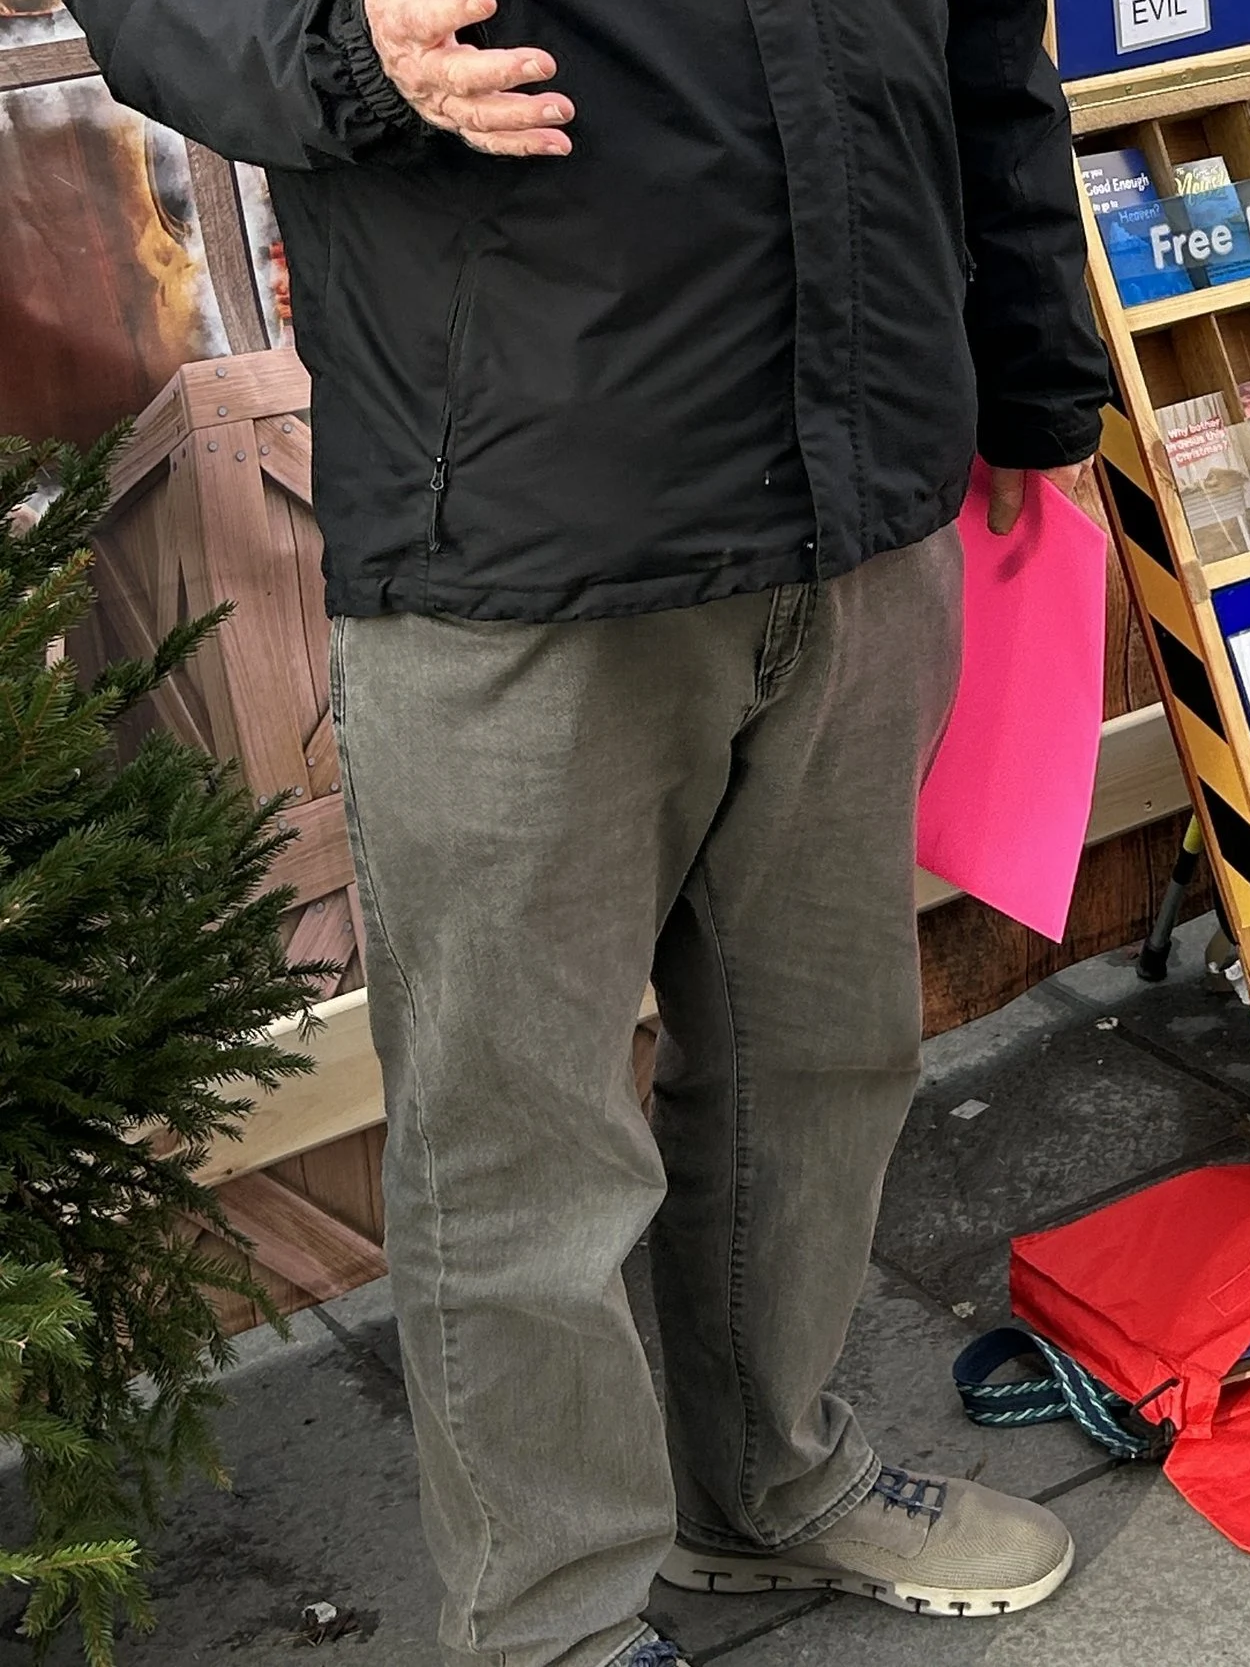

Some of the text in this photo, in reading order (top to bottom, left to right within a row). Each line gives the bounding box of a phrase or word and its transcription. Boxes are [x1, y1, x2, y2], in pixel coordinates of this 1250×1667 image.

[1085, 173, 1149, 196] Good Enough
[1119, 204, 1160, 224] Heaven?
[1150, 222, 1233, 270] Free
[1168, 428, 1188, 439] Why
